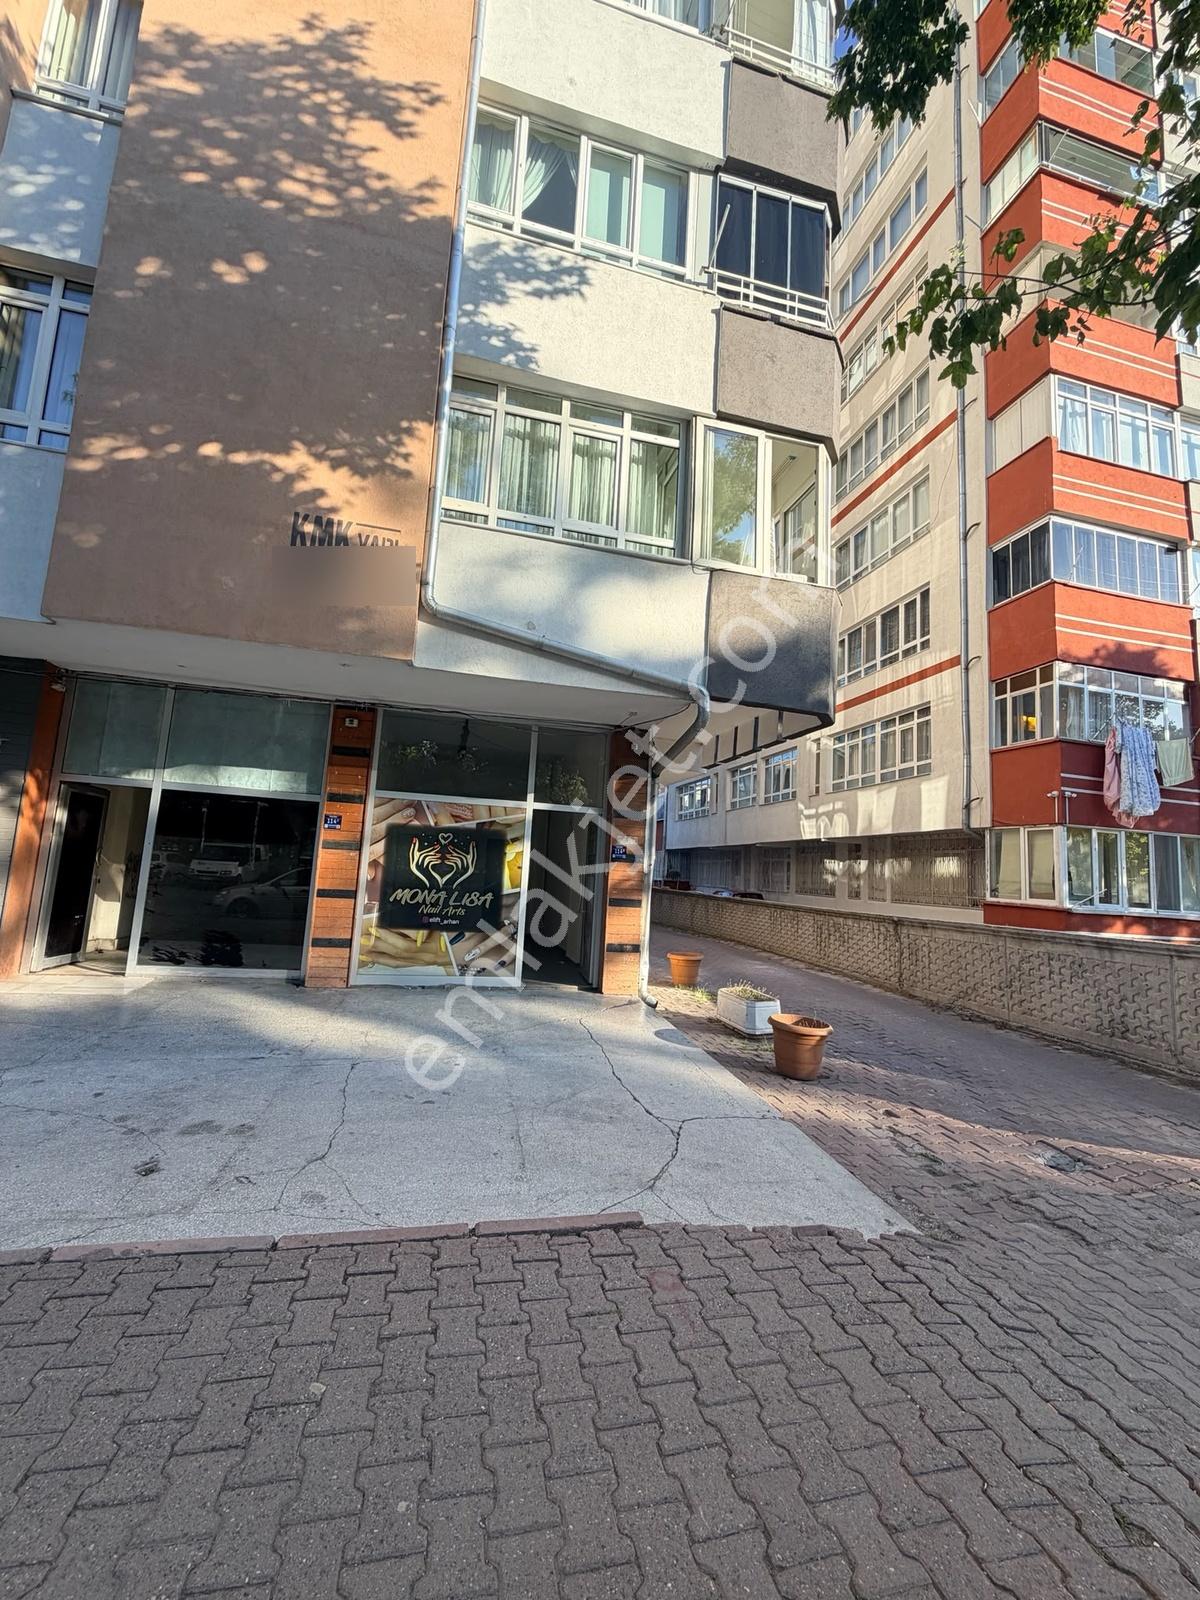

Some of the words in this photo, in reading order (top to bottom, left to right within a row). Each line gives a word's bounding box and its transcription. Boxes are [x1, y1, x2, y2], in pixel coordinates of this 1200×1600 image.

[389, 888, 448, 905] MONA
[418, 904, 441, 914] Nail
[442, 906, 466, 916] Arts
